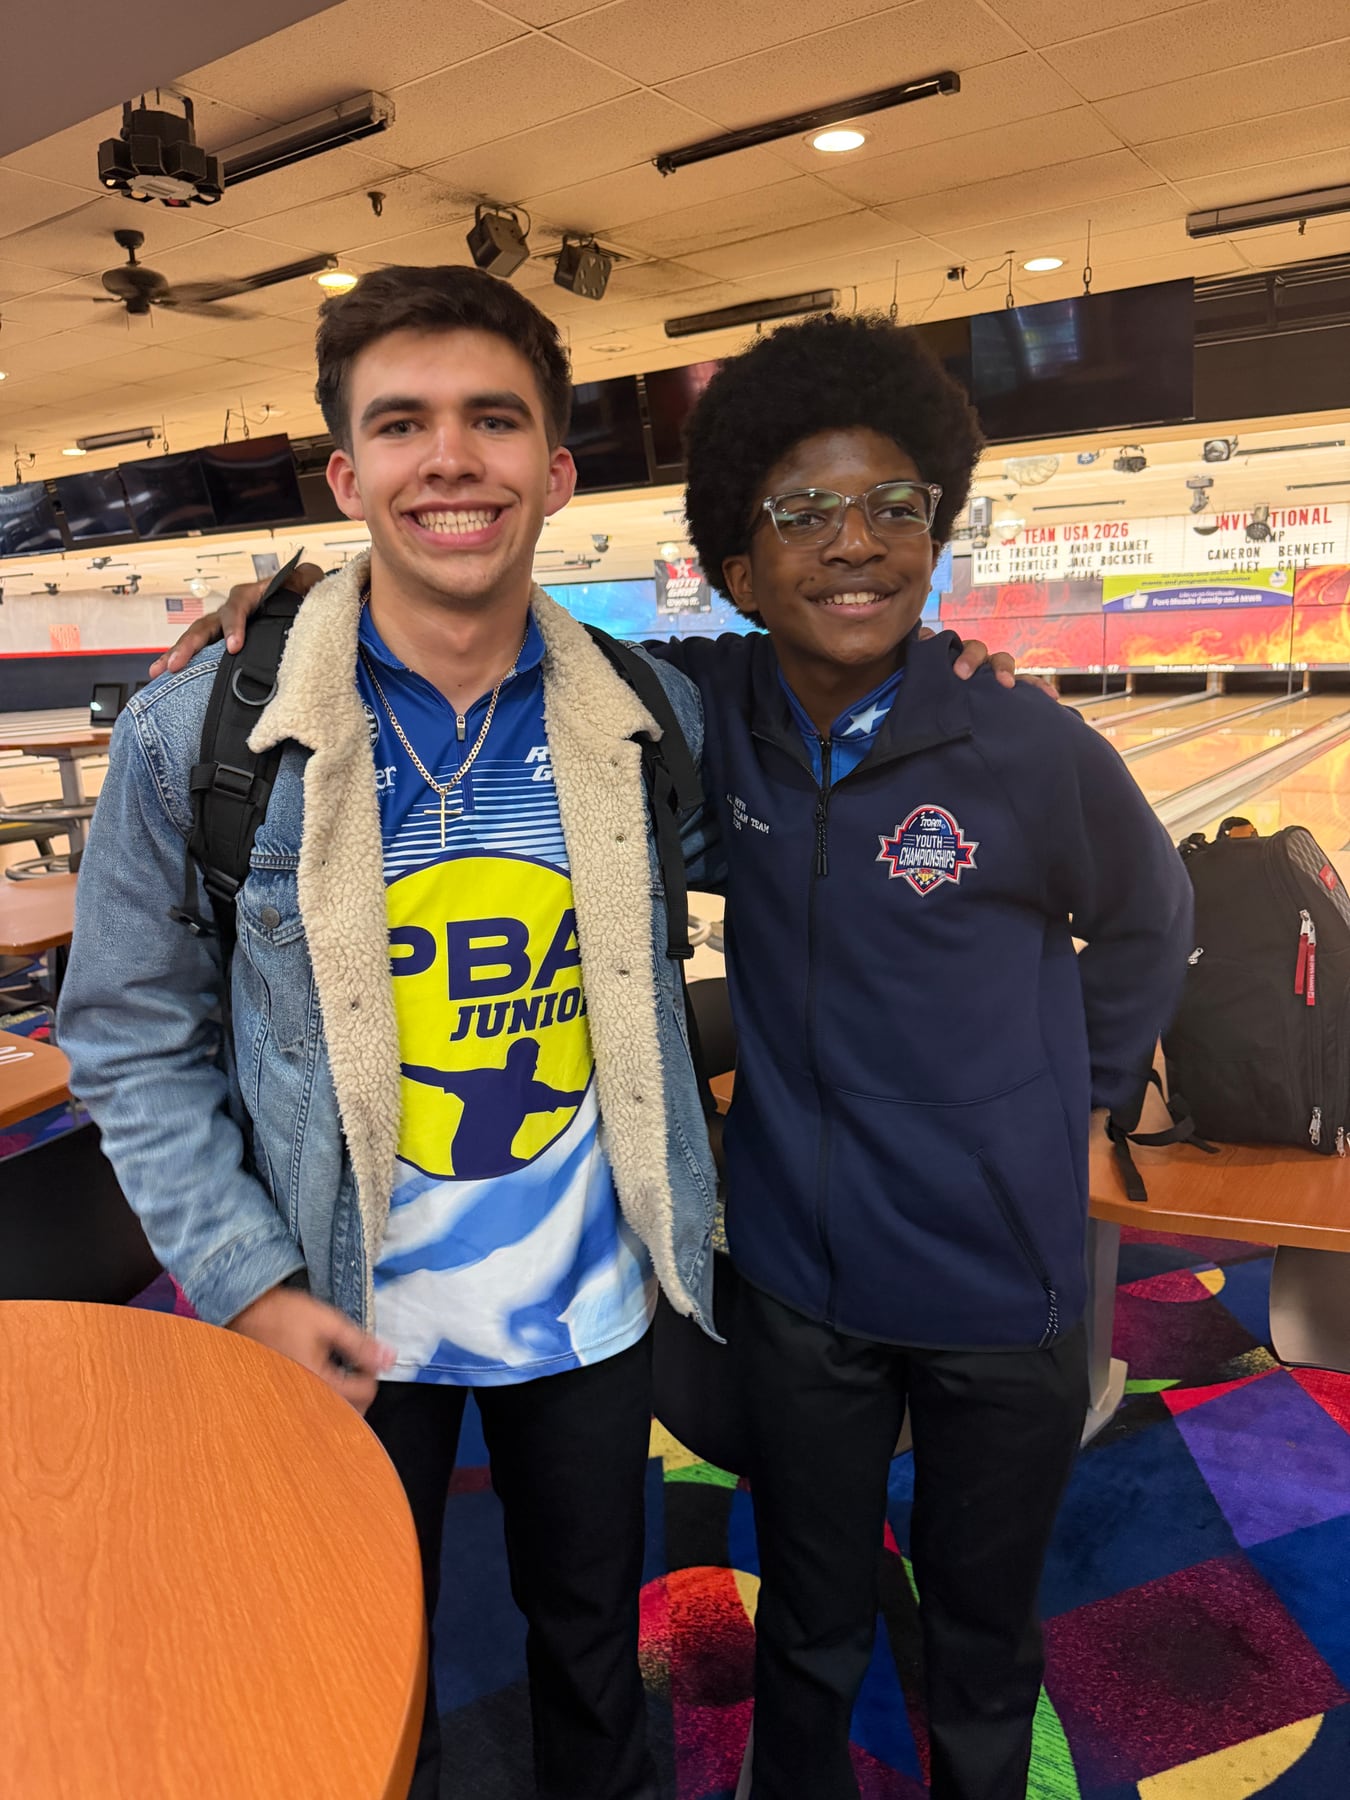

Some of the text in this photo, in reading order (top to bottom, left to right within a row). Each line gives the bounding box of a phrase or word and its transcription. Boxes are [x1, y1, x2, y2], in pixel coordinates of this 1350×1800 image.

[1215, 506, 1333, 531] INVITIONAL
[1025, 527, 1056, 545] TEAM
[1063, 524, 1089, 542] USA
[1094, 521, 1129, 540] 2026
[1245, 530, 1285, 545] CMP
[1207, 541, 1336, 561] CAMERON BENNETT
[1230, 560, 1260, 574] ALEX
[750, 817, 770, 834] TEAM
[915, 834, 943, 849] YOUTH
[899, 846, 956, 869] CHAMPIONSHIPS
